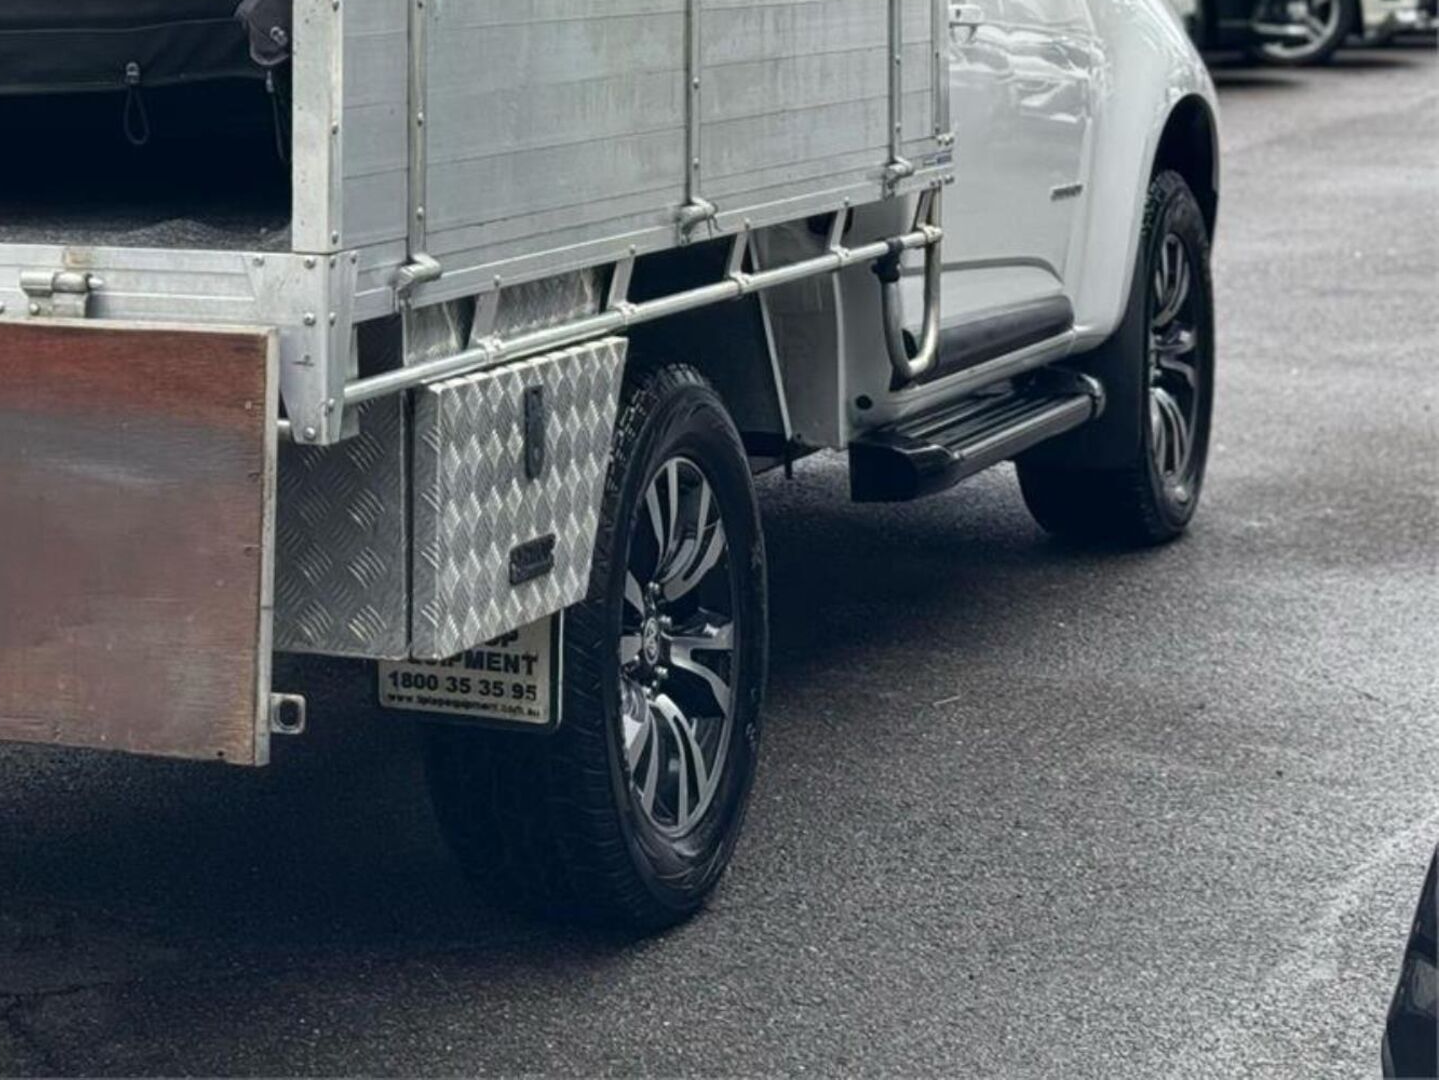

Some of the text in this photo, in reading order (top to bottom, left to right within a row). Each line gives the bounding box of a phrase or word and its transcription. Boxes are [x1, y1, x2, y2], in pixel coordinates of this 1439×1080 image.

[388, 670, 538, 702] 1800 35 35 95
